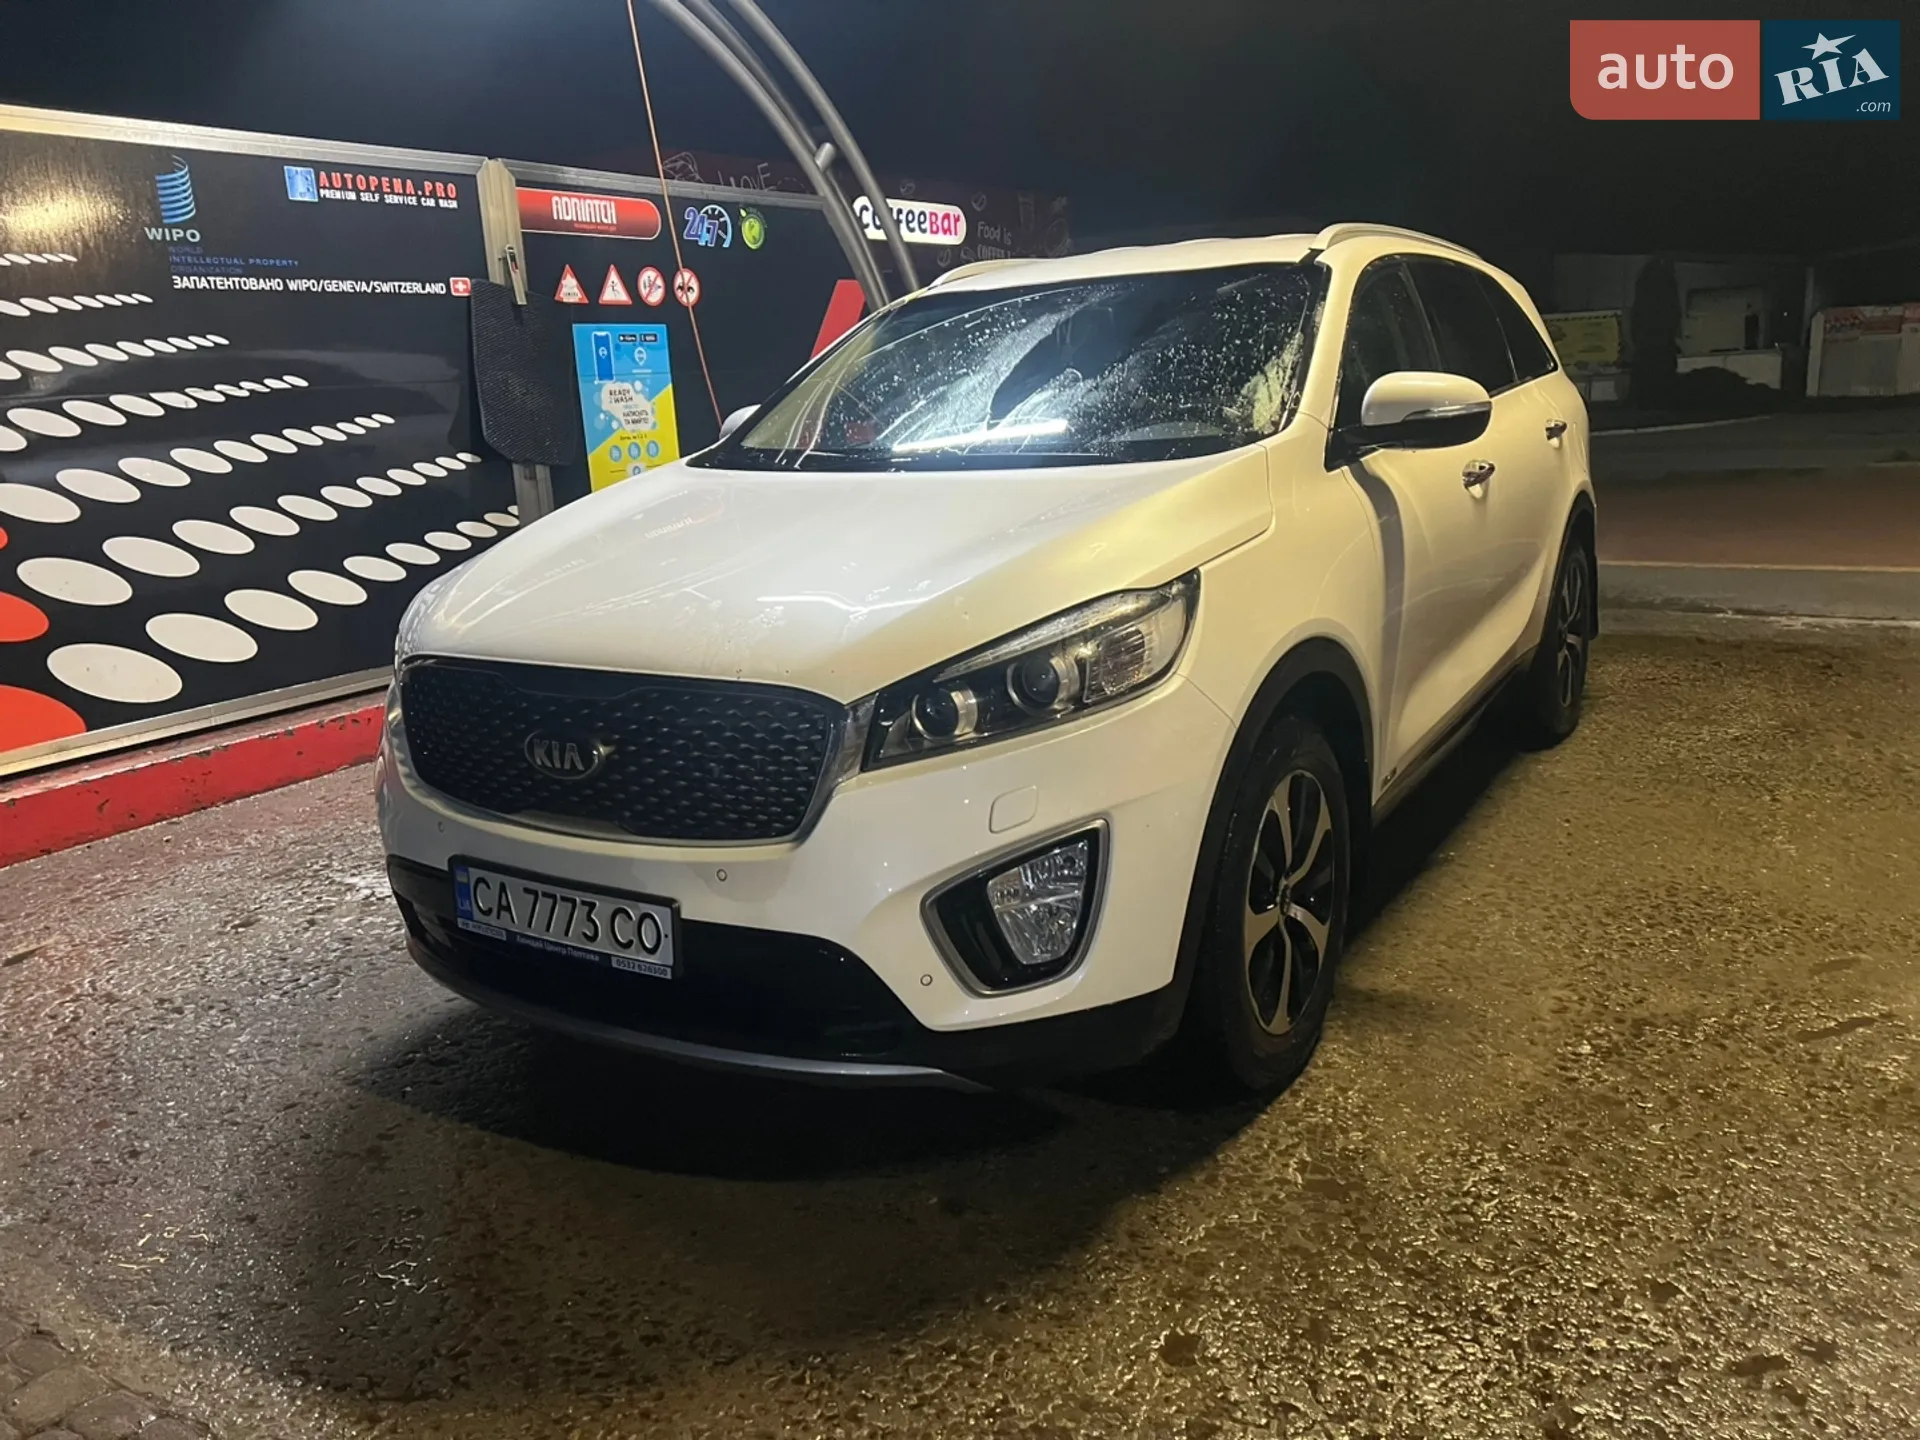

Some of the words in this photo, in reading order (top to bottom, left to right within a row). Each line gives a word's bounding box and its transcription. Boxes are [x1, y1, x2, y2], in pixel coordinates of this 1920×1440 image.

[319, 171, 458, 199] AUTOPENA.PRO
[319, 188, 357, 201] PREMIUM
[360, 192, 380, 203] SELF
[384, 194, 418, 206] SERVICE
[420, 197, 436, 208] CAR
[439, 199, 459, 209] WASH
[144, 227, 202, 243] WIPO
[977, 221, 1001, 242] Food
[169, 255, 246, 266] INTELLECTUAL
[248, 258, 299, 268] PROPERTY
[172, 275, 283, 292] ЗАПАТЕНТОВАНО
[286, 279, 447, 295] WIPO/GENEVA/SWITZERLAND
[533, 738, 585, 771] KIA
[472, 876, 519, 925] CA
[522, 886, 601, 944] 7773
[610, 905, 663, 956] CO
